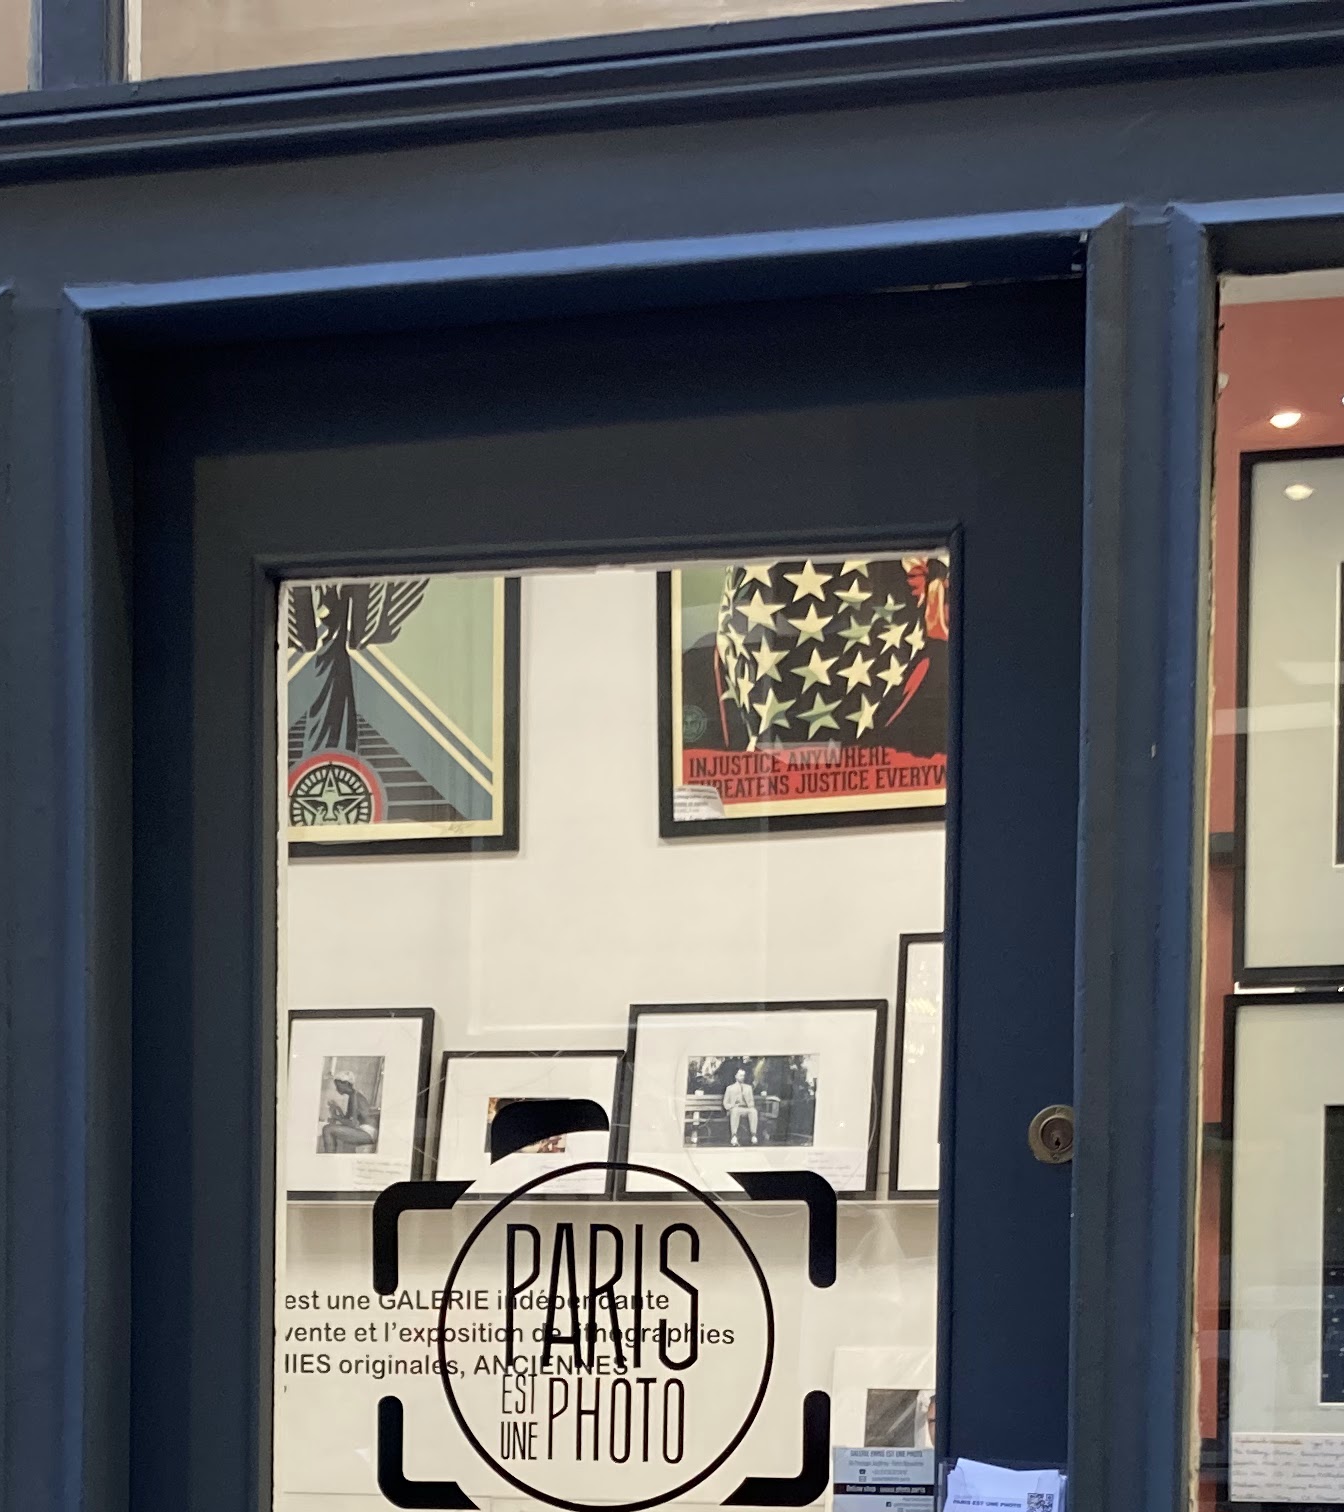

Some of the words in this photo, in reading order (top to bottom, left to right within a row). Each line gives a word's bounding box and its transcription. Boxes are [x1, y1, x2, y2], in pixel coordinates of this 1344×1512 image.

[689, 751, 781, 777] INJUSTICE
[786, 746, 891, 772] ANYWHERE
[688, 774, 789, 799] REATENS
[795, 770, 866, 794] JUSTICE
[327, 1293, 370, 1311] une
[378, 1289, 489, 1311] GALERIE
[505, 1222, 700, 1371] PARIS
[354, 1322, 377, 1342] et
[574, 1322, 736, 1349] ithographies
[338, 1354, 465, 1380] originales,
[473, 1355, 629, 1376] ANCIENNES
[501, 1374, 538, 1415] EST
[500, 1421, 538, 1461] UNE
[547, 1377, 685, 1464] PHOTO
